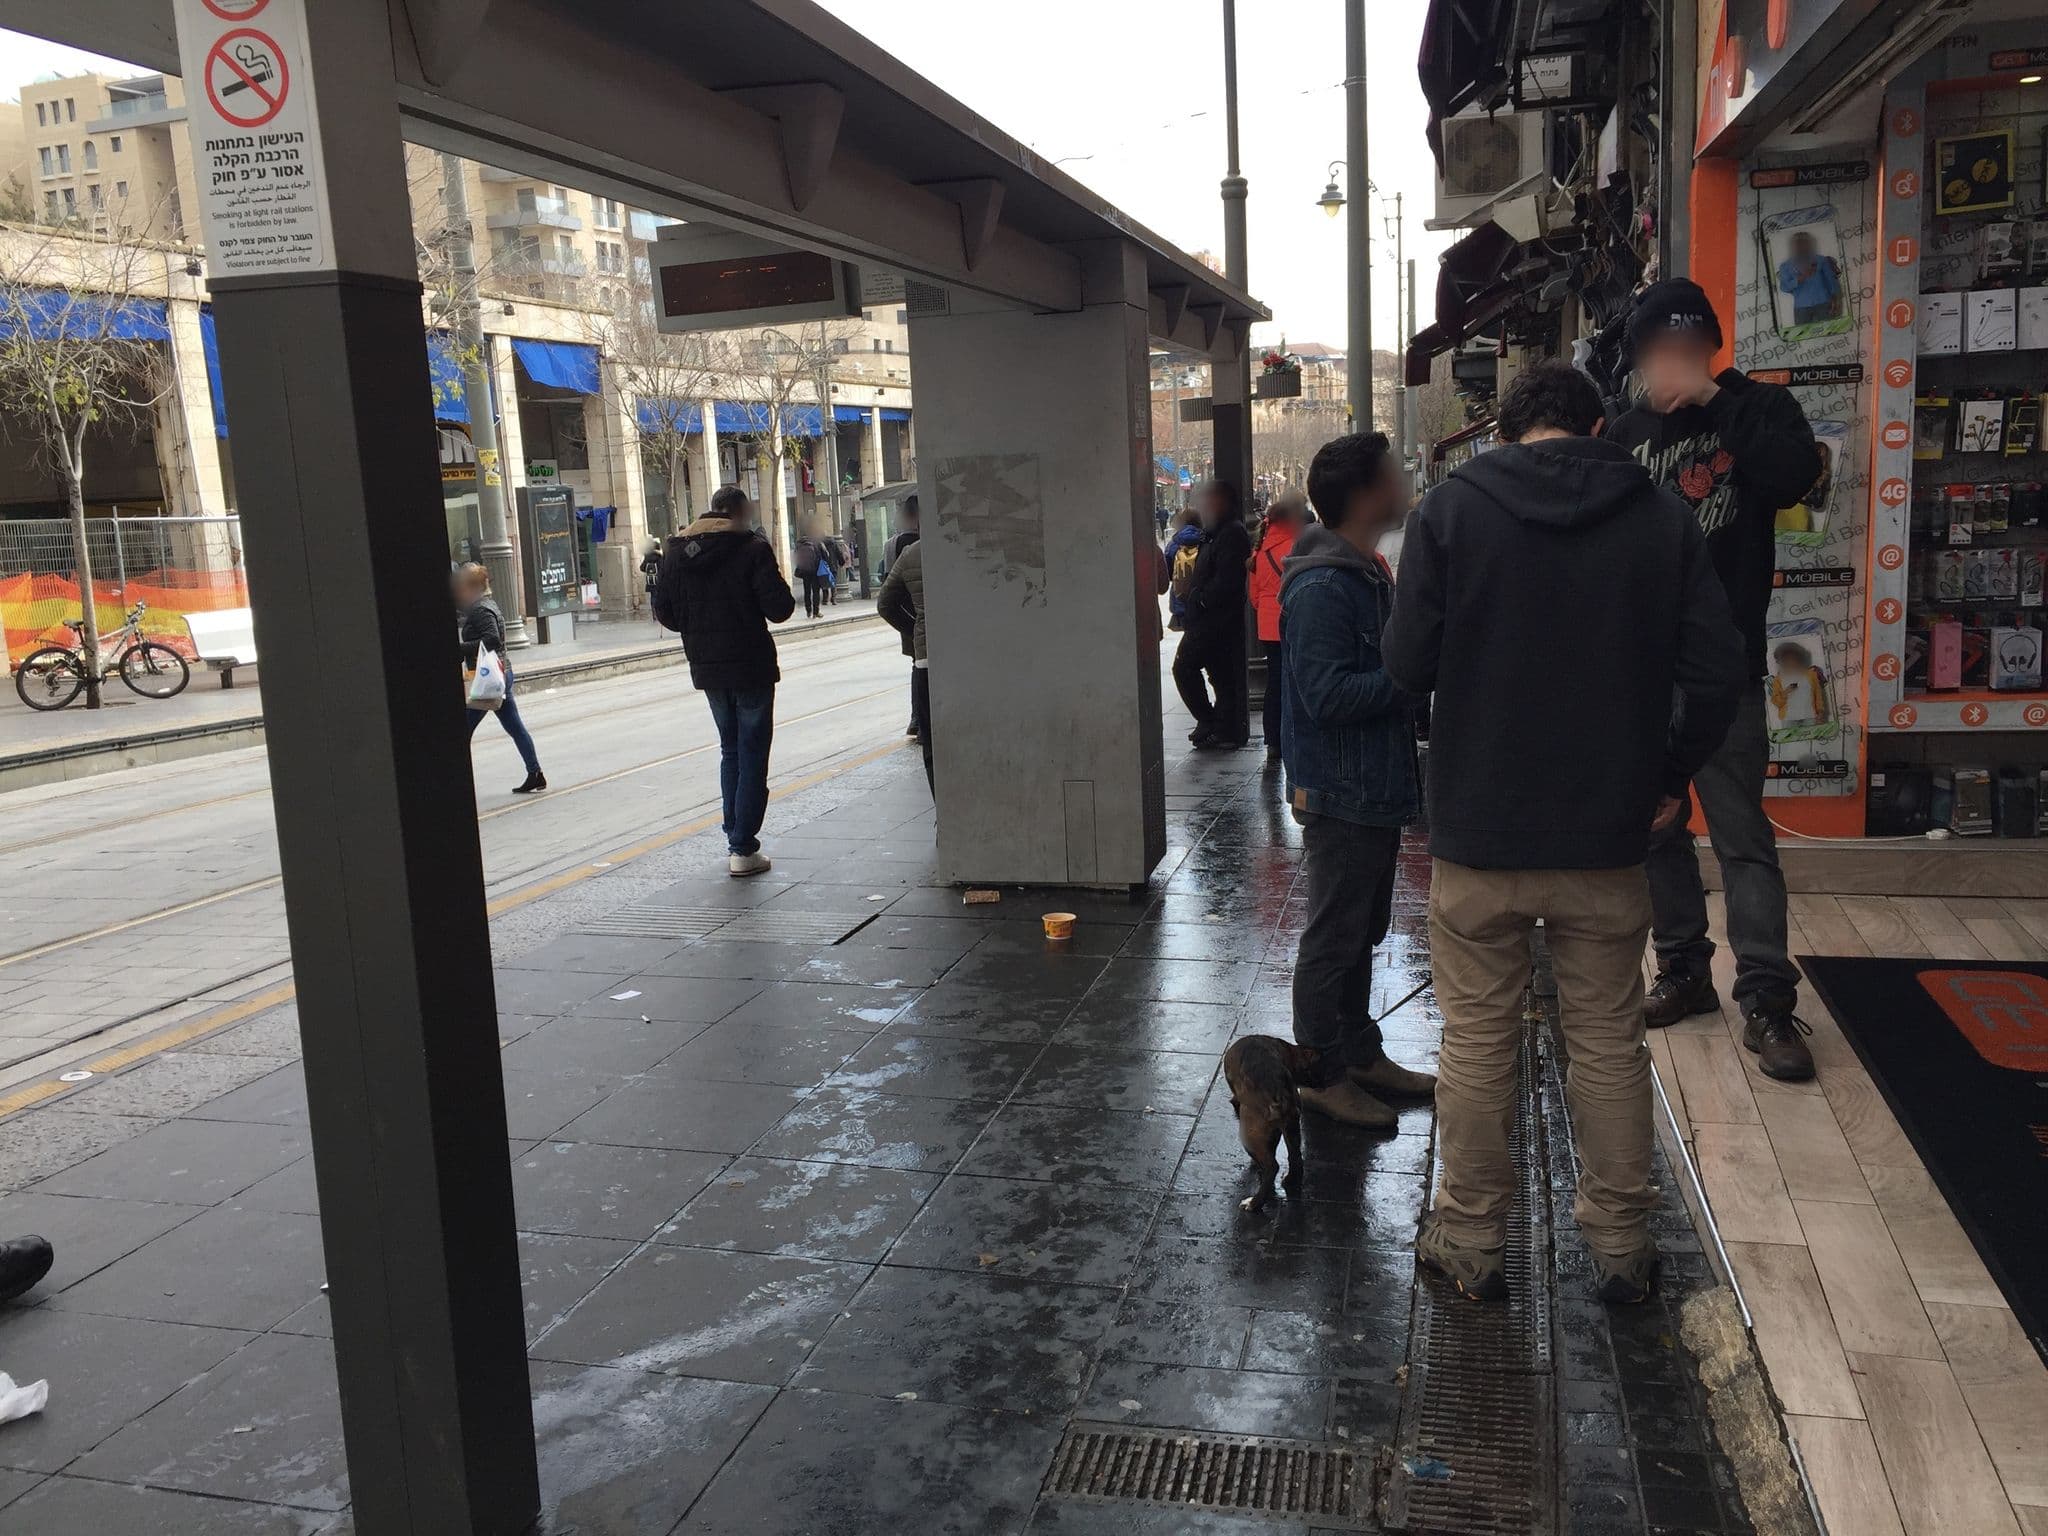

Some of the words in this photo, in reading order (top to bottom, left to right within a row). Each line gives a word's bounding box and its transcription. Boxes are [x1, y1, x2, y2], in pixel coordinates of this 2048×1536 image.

[205, 136, 254, 151] בתחנות
[259, 131, 304, 149] העישון
[213, 152, 250, 168] הקלה
[255, 148, 299, 163] הרכבת
[270, 164, 304, 177] אסור
[1798, 164, 1867, 182] MOBILE
[212, 171, 236, 185] חוק
[212, 210, 242, 220] Smoking
[253, 207, 269, 218] light
[271, 206, 283, 215] rail
[284, 204, 314, 215] stations
[229, 220, 235, 229] is
[237, 218, 272, 228] forbidden
[273, 217, 282, 226] by
[219, 238, 238, 248] לקנס
[257, 236, 277, 245] החוק
[226, 259, 254, 268] Violators
[256, 259, 266, 267] are
[267, 256, 290, 267] subject
[290, 256, 297, 264] to
[298, 255, 311, 263] fine
[1792, 368, 1861, 382] MOBILE
[1881, 484, 1906, 500] 4G
[1786, 571, 1852, 584] MOBILE
[1789, 601, 1816, 617] Get
[1817, 586, 1866, 610] Mobile
